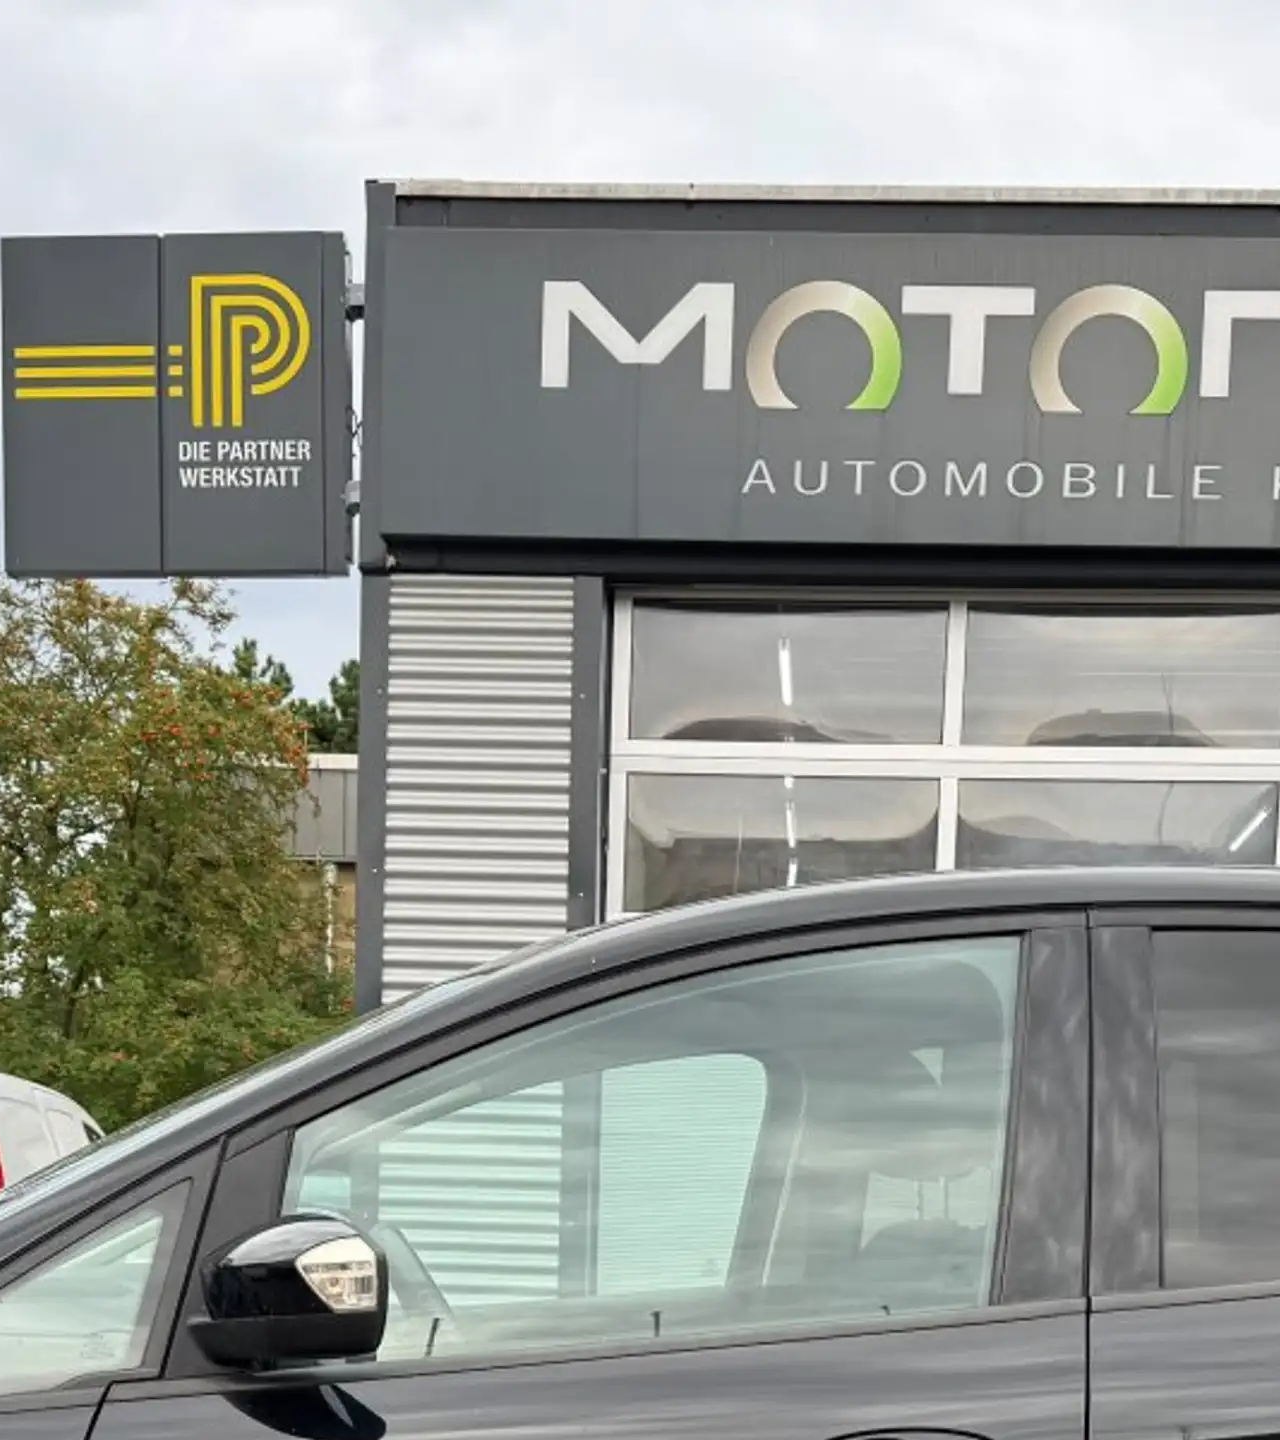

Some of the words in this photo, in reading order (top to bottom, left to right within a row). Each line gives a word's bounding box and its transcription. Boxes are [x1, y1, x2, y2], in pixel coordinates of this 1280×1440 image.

[178, 441, 211, 462] DIE
[216, 439, 312, 463] PARTNER
[178, 465, 302, 489] WERKSTATT
[741, 458, 1224, 501] AUTOMOBILE
